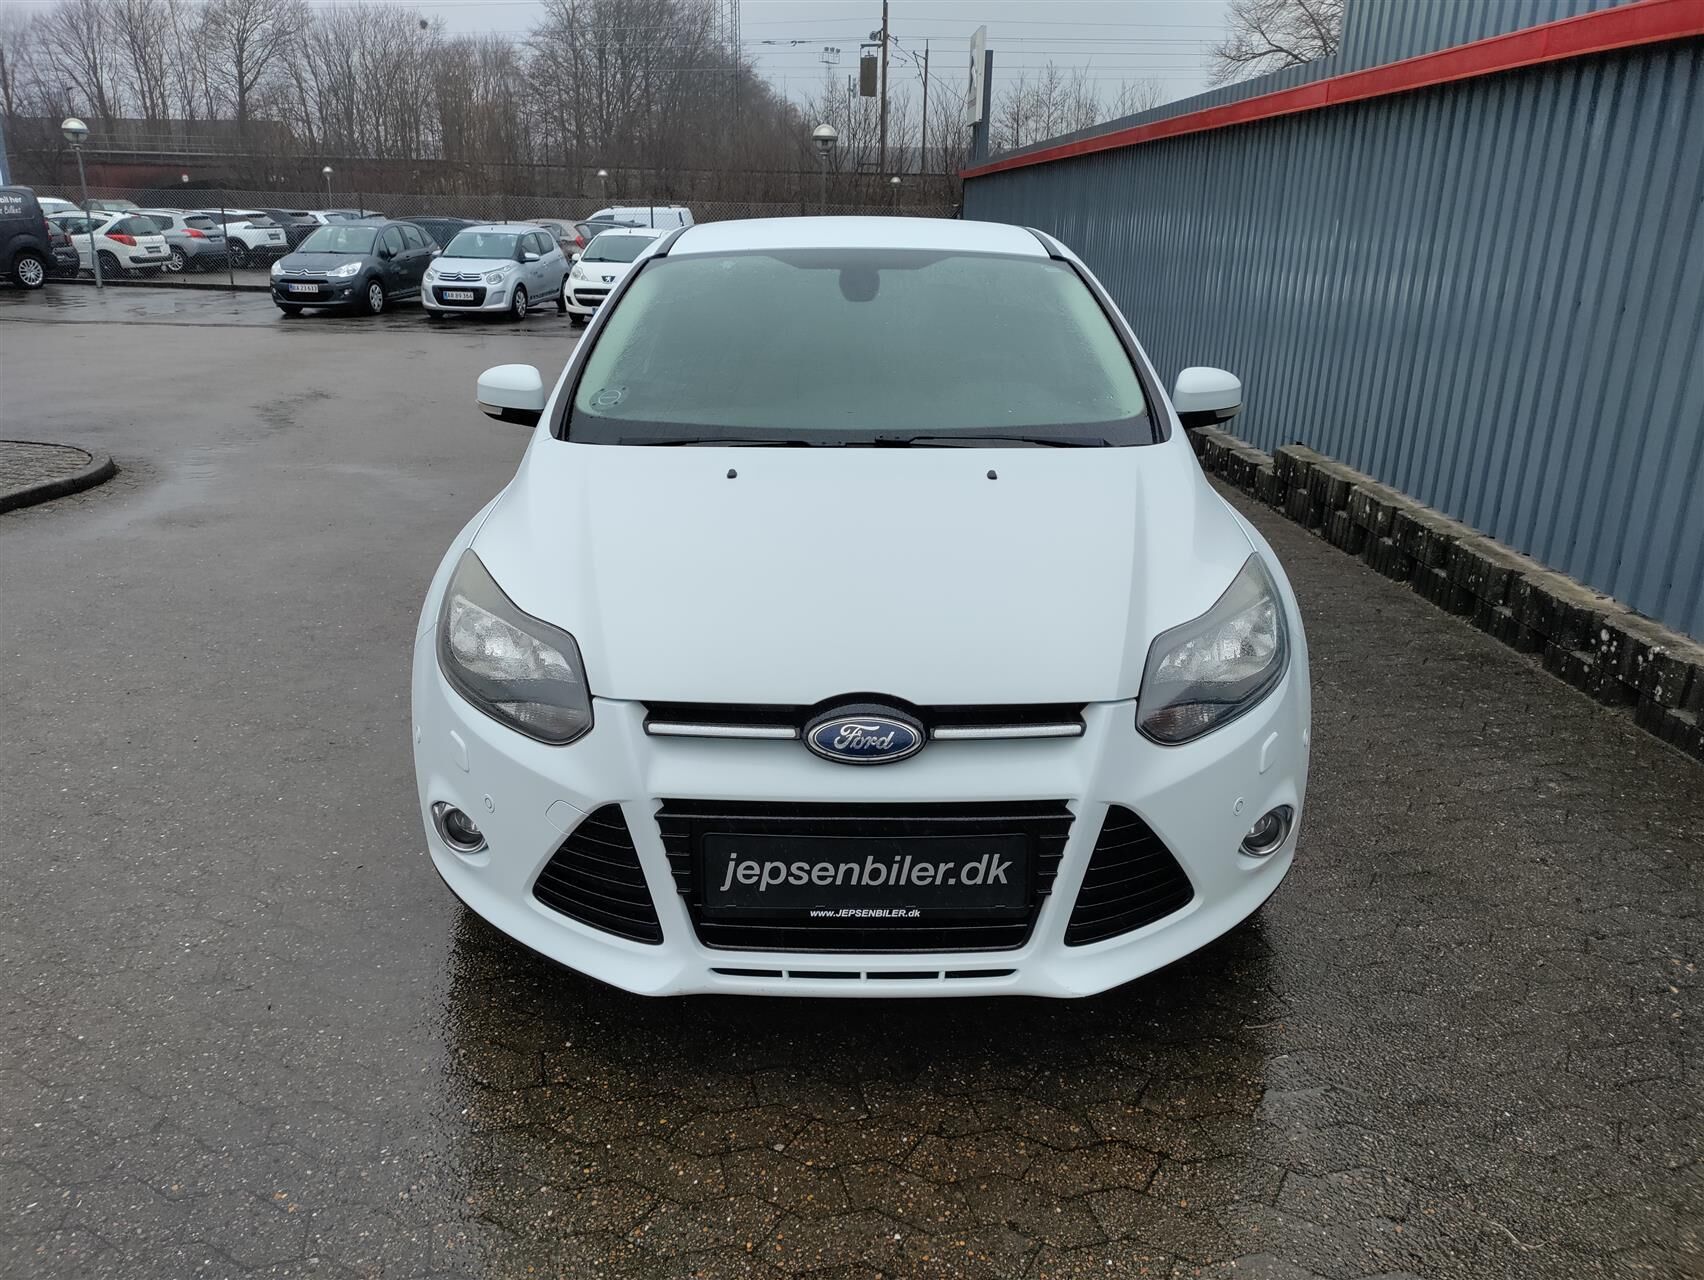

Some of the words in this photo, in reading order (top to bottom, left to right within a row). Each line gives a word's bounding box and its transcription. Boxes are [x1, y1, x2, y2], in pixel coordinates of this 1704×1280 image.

[833, 724, 895, 750] Ford
[720, 852, 1013, 892] jepsenbiler.dk
[810, 908, 920, 918] www.JEPSENBILER.dk
